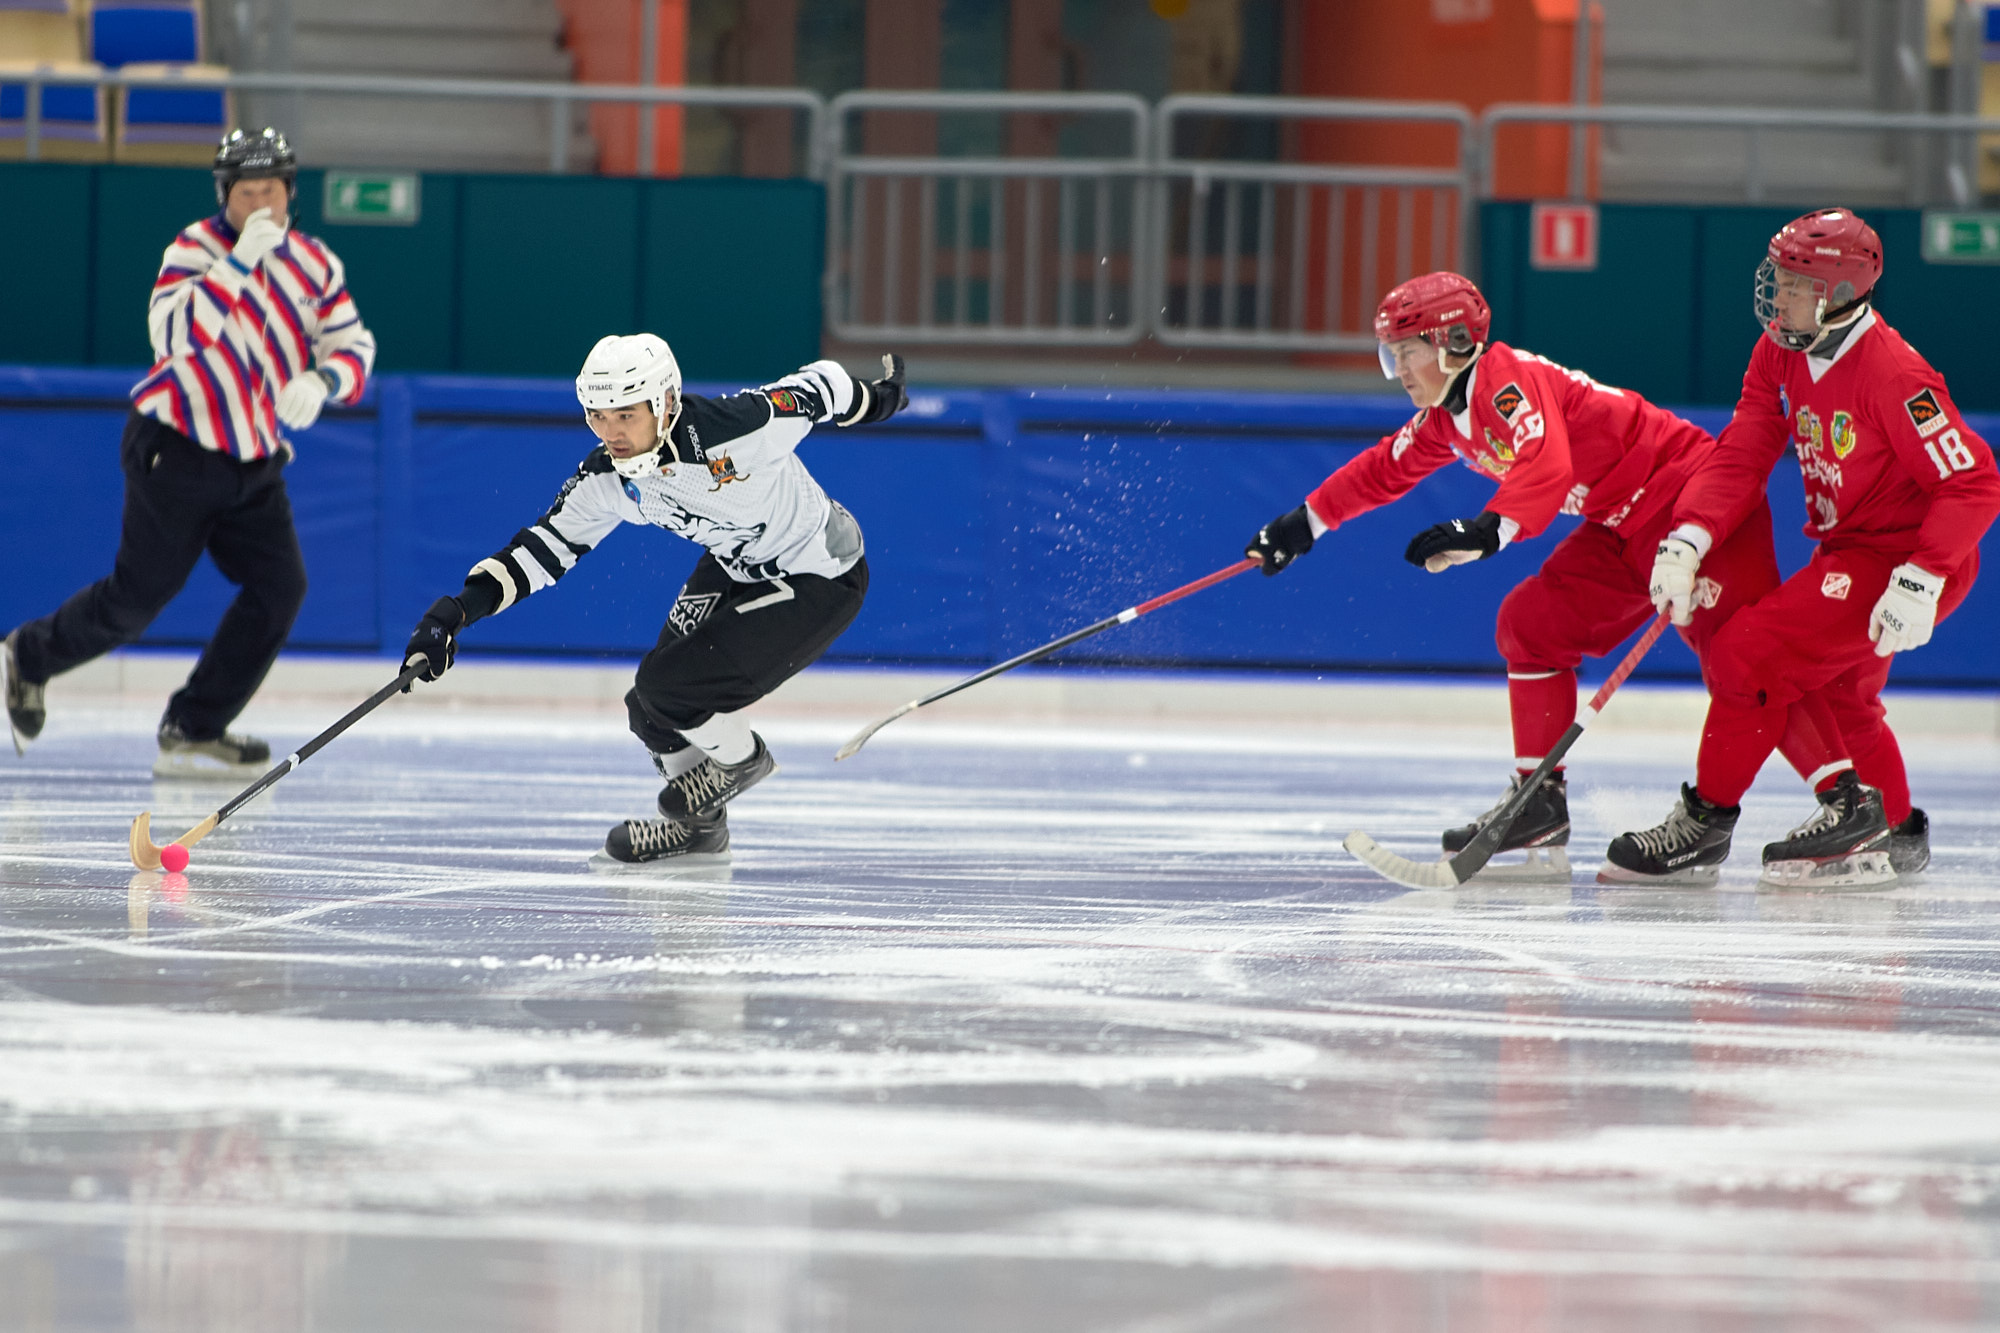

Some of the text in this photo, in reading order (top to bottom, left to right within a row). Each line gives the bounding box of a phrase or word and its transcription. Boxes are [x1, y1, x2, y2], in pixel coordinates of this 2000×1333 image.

[1924, 428, 1975, 480] 18
[734, 578, 795, 615] 7
[668, 600, 697, 635] БАС
[1881, 609, 1904, 632] 5055
[1667, 851, 1699, 867] CCM
